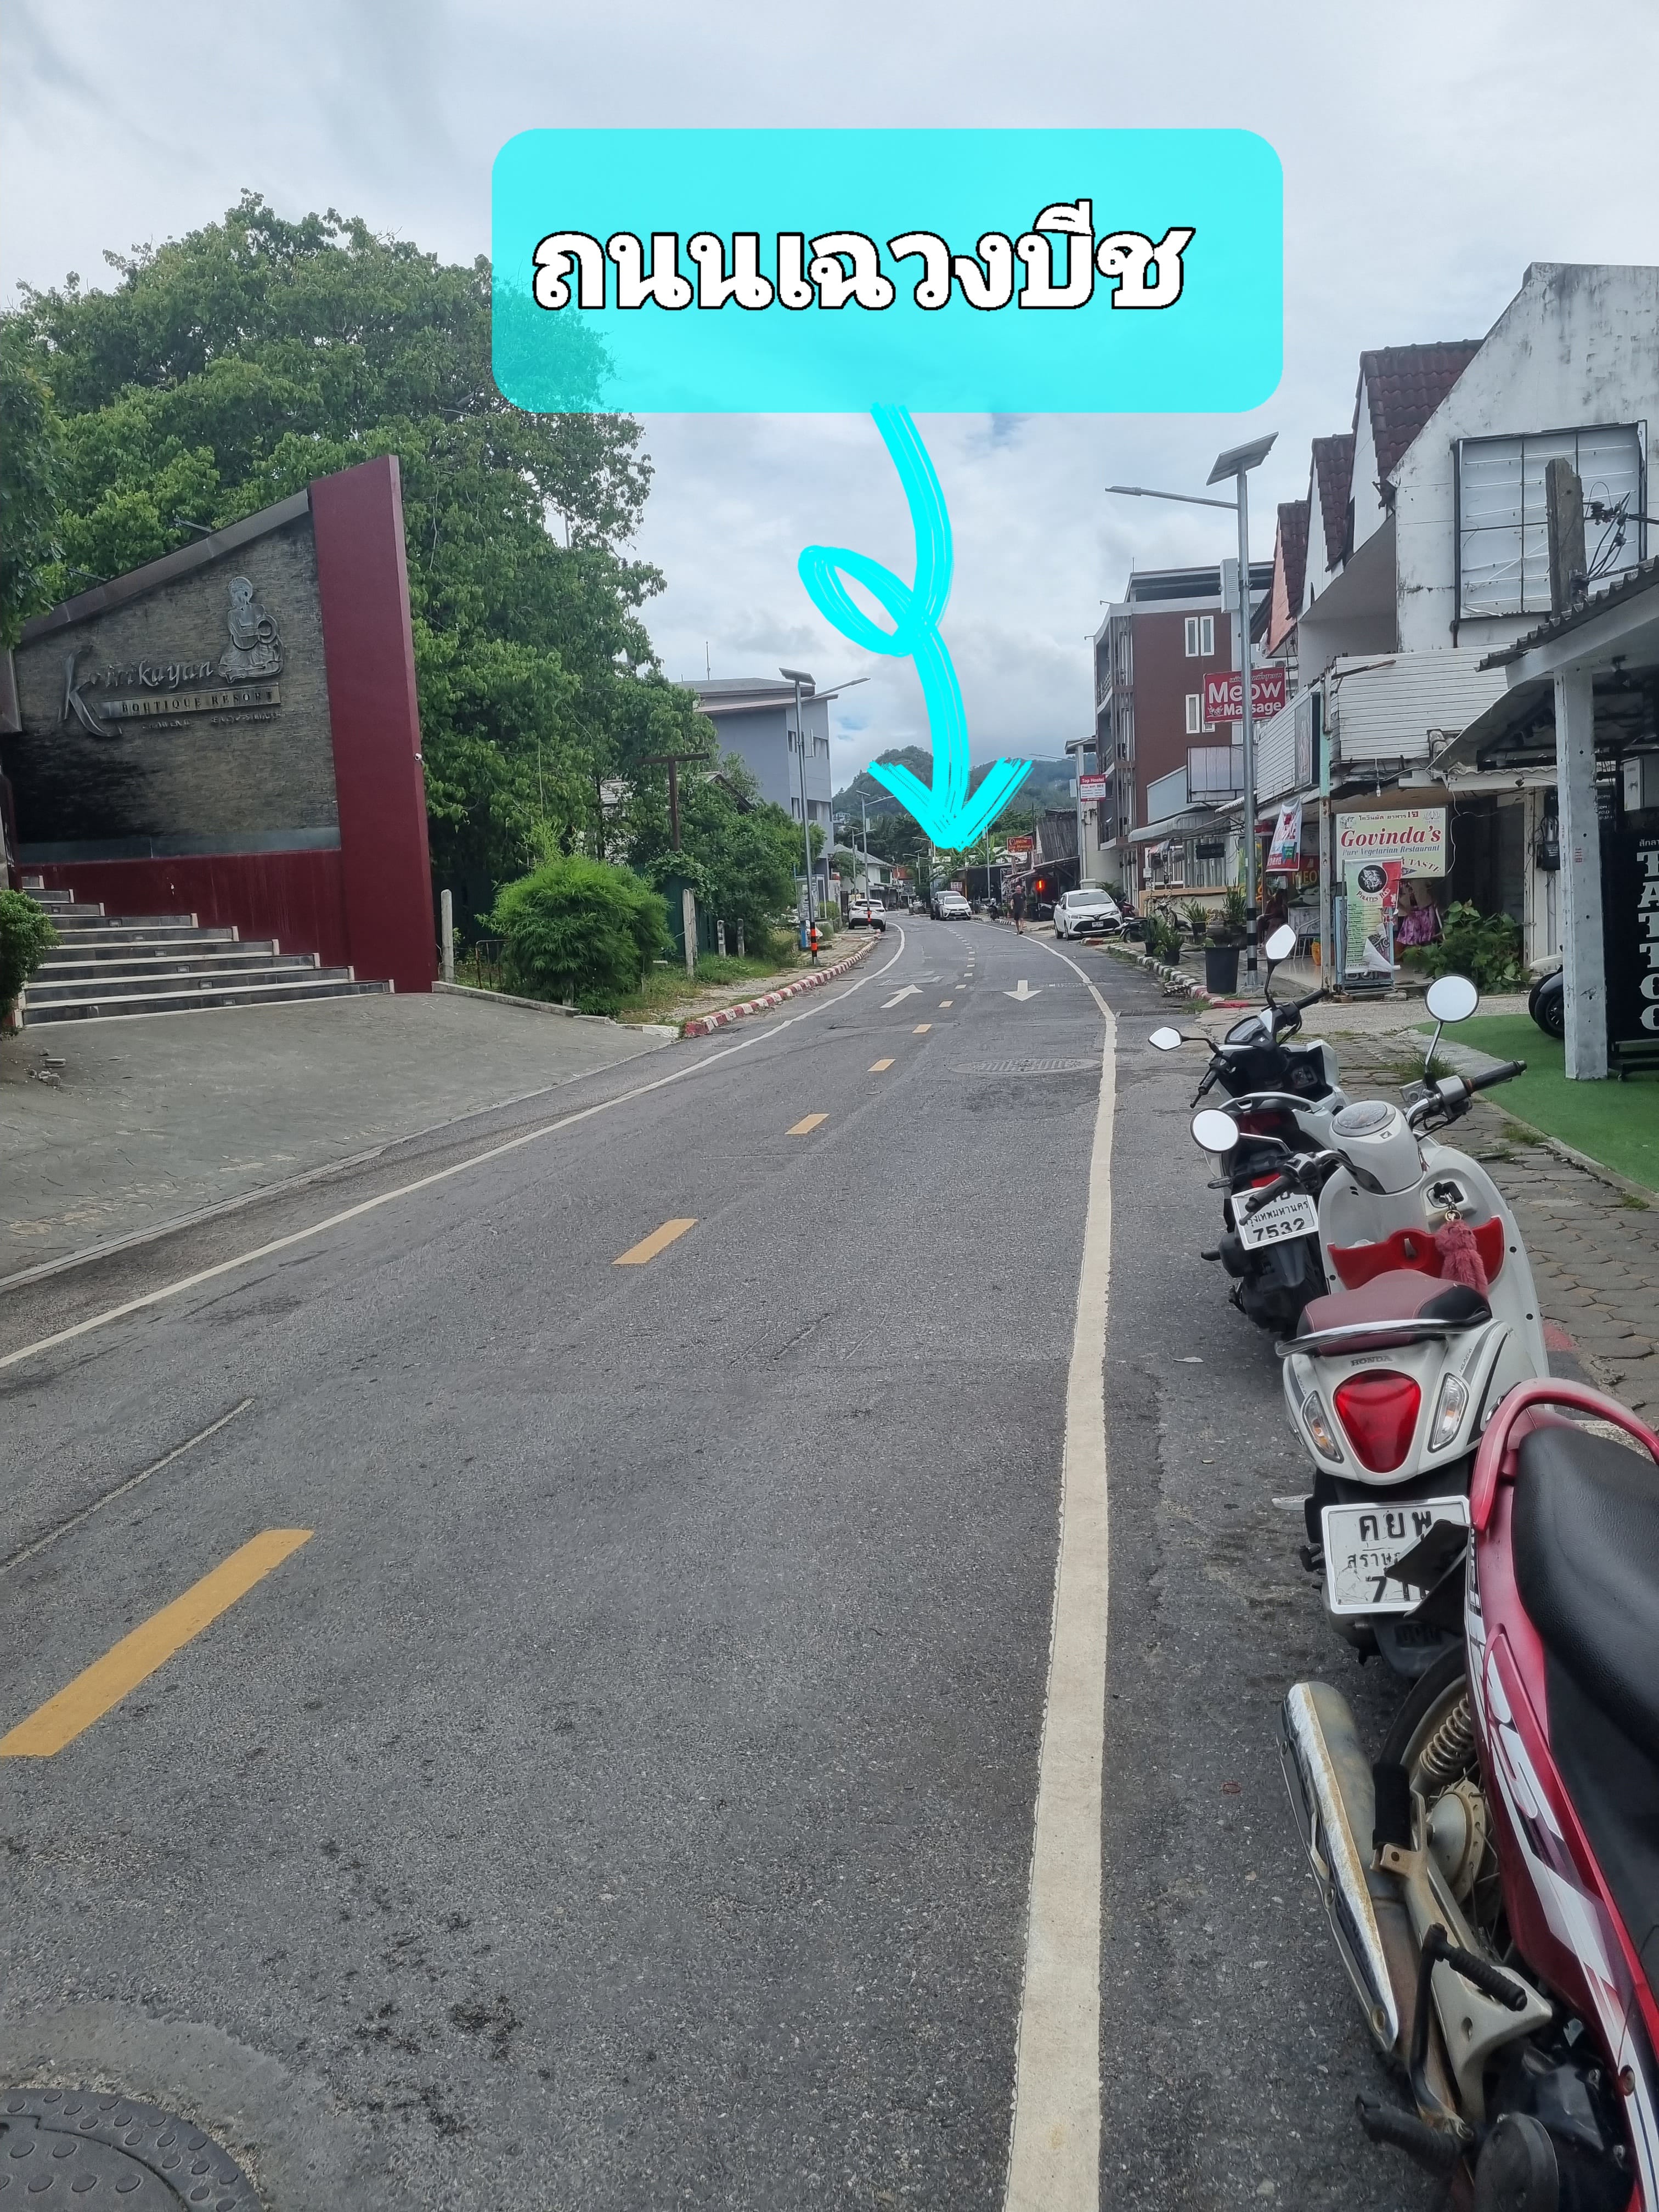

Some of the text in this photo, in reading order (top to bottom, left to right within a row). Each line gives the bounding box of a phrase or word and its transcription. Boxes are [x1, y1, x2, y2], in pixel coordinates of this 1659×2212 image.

[122, 691, 273, 713] BOUTIQUE RESORT
[1223, 702, 1282, 716] Masage
[1341, 825, 1441, 847] Govinda's
[1360, 847, 1398, 856] Vegetarian
[1400, 845, 1440, 853] Restaurant
[1408, 857, 1442, 873] TASTE
[1292, 870, 1321, 884] MEO
[1356, 890, 1379, 902] PIRATES
[1252, 1217, 1307, 1242] 7532
[1351, 1356, 1393, 1366] HONDA
